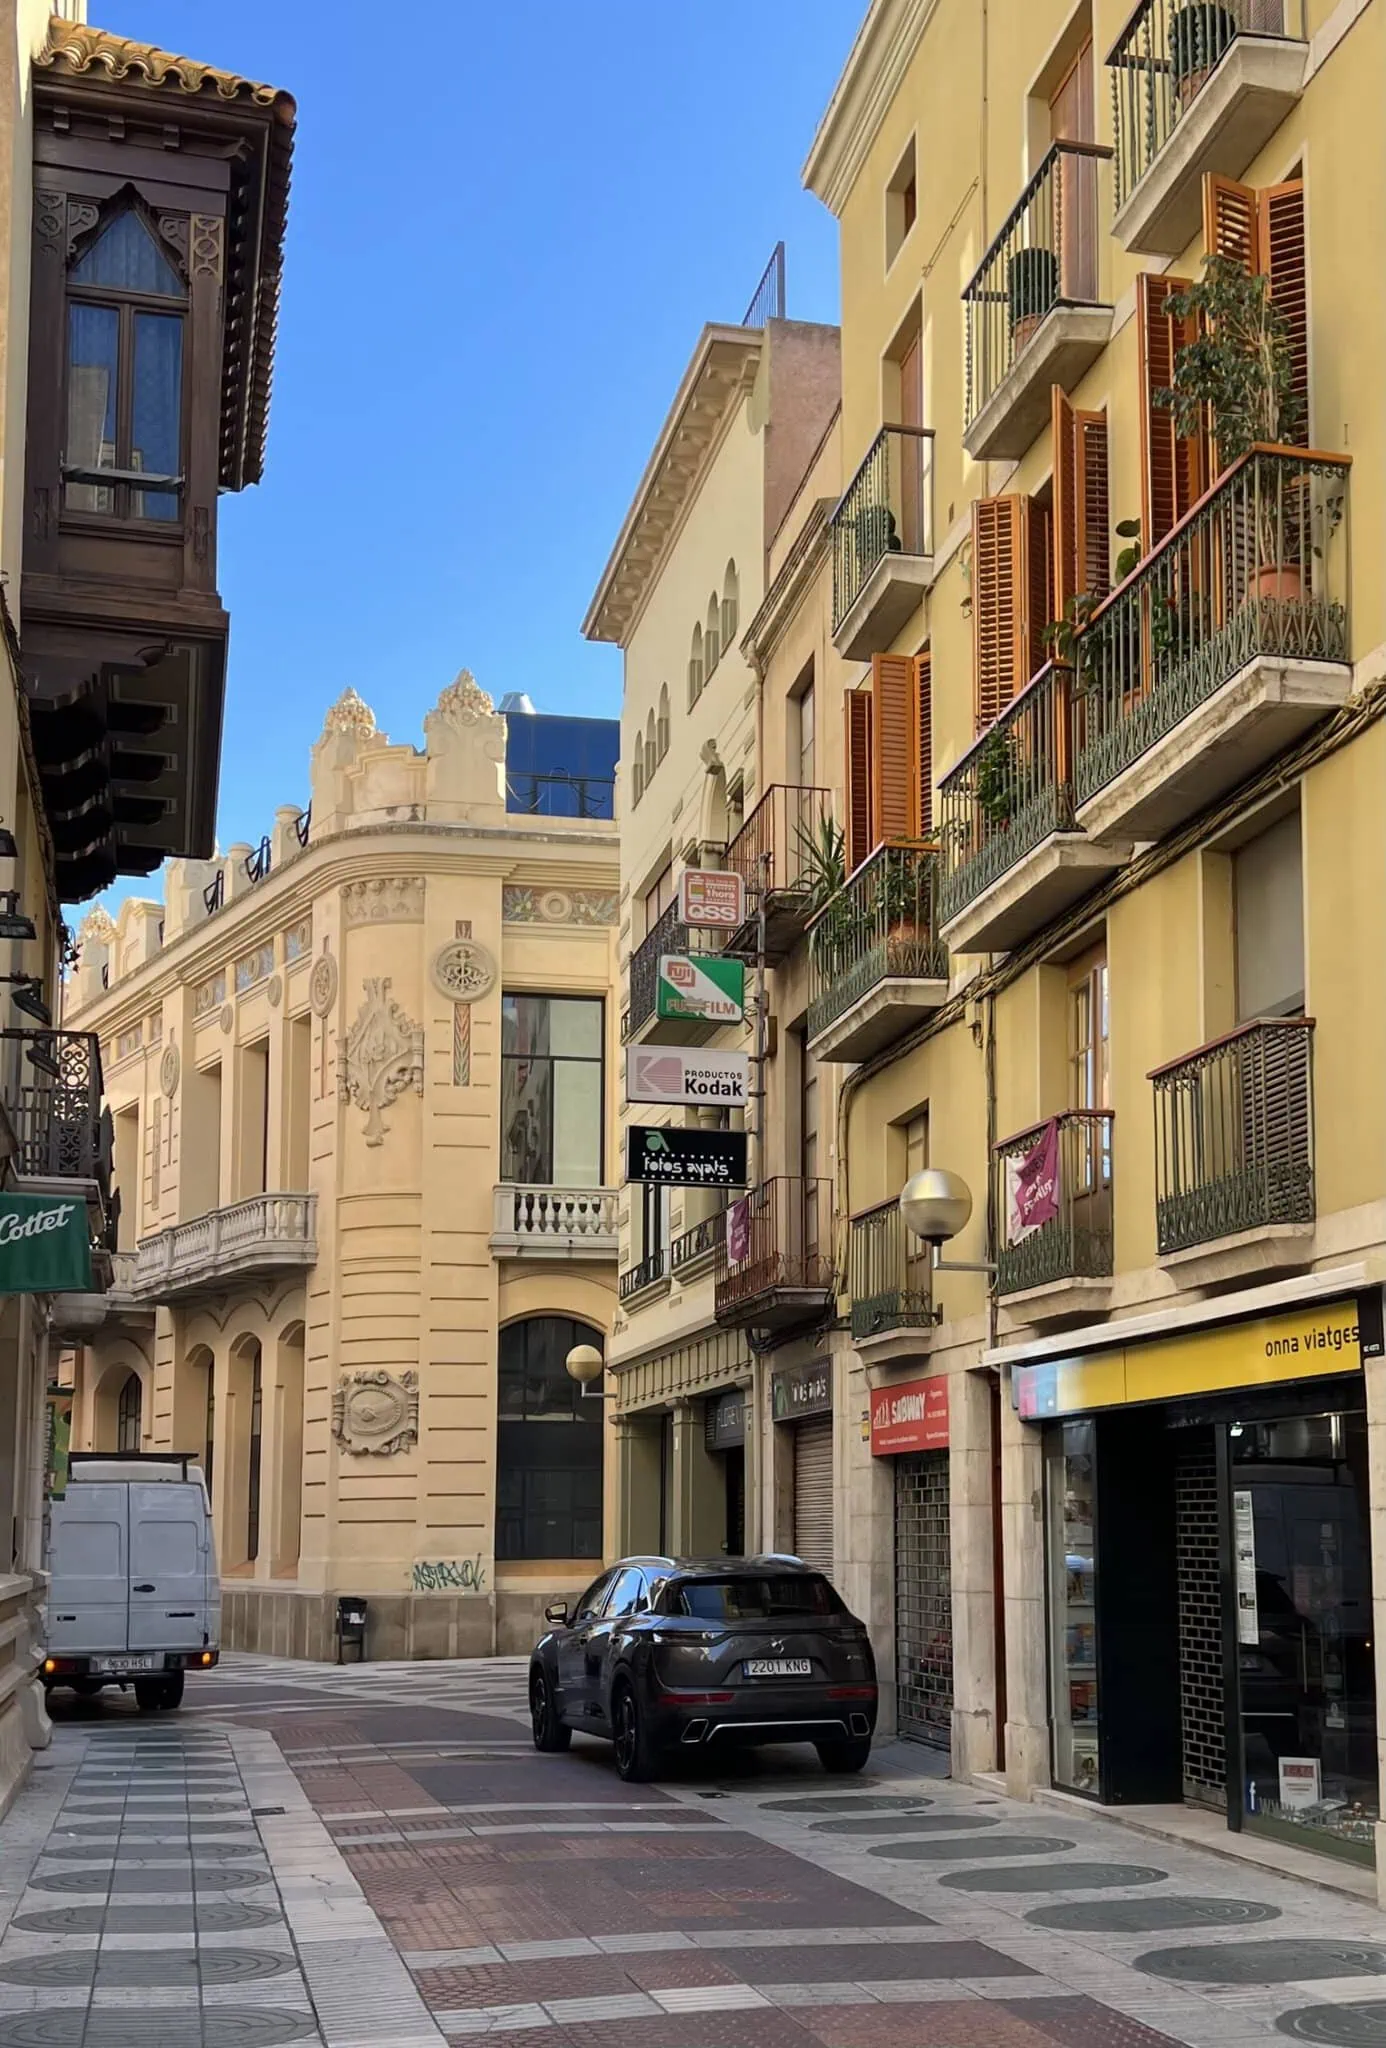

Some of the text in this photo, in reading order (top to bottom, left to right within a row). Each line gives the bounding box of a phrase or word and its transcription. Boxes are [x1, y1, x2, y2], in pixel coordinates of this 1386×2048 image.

[688, 904, 737, 921] QSS
[685, 1070, 743, 1080] PRODUCTOS
[685, 1078, 743, 1097] Kodak
[644, 1156, 729, 1178] fotos ayats
[0, 1203, 76, 1245] Cottet
[1265, 1337, 1299, 1357] onna
[1304, 1325, 1360, 1351] viatges
[752, 1660, 809, 1673] 2201 KNG
